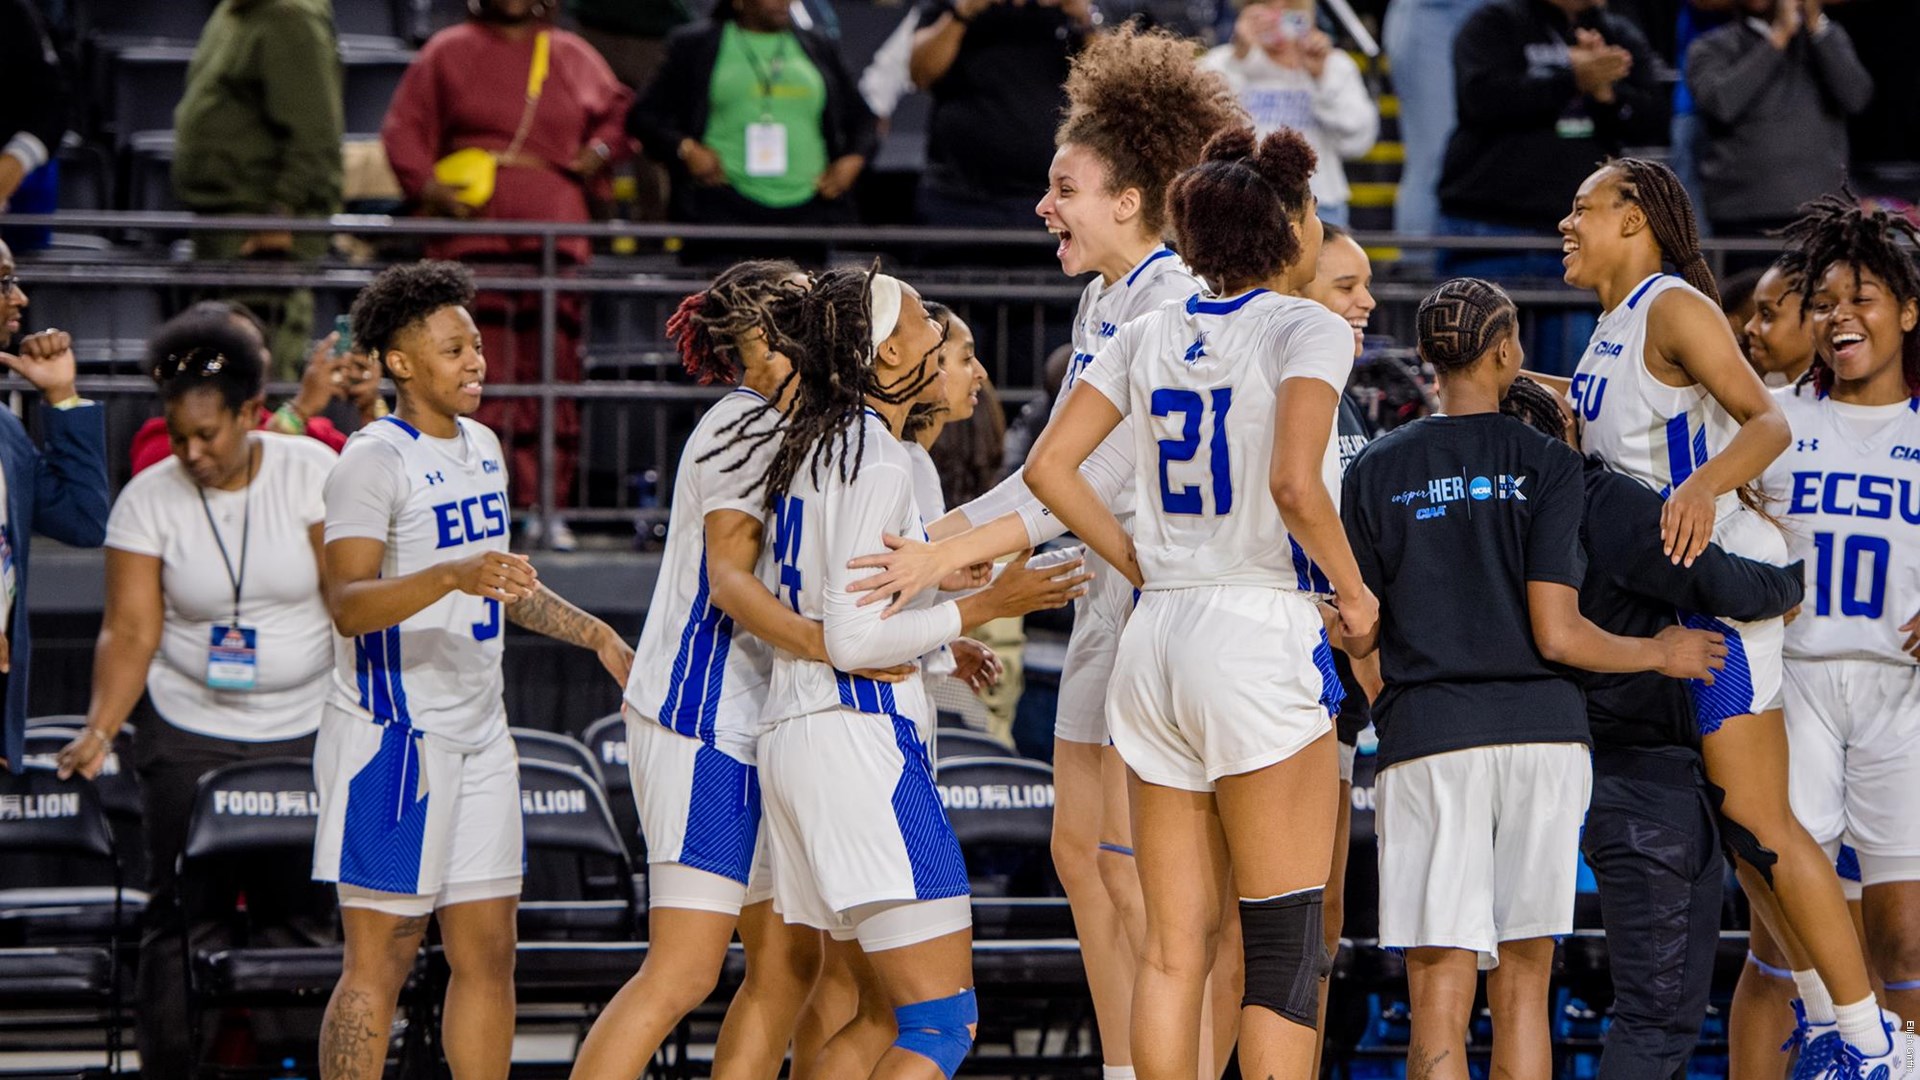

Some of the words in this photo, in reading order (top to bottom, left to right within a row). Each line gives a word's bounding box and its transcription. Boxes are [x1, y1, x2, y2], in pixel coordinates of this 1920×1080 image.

[1150, 387, 1233, 515] 21
[1787, 471, 1920, 525] ECSU
[1416, 505, 1446, 520] CIAA
[1814, 532, 1890, 619] 10
[24, 793, 79, 818] LION
[214, 790, 275, 815] FOOD
[533, 789, 586, 814] LION
